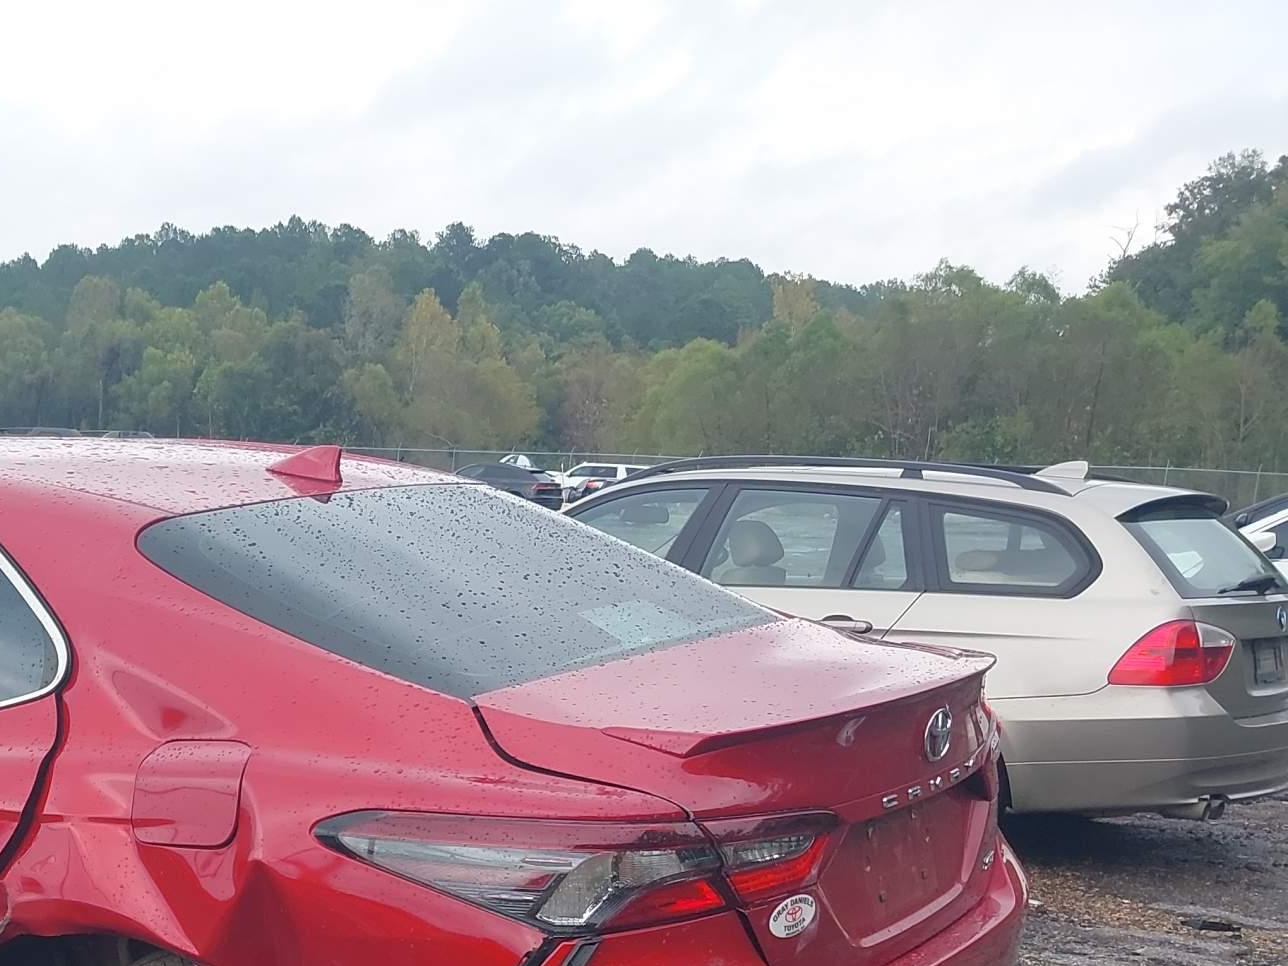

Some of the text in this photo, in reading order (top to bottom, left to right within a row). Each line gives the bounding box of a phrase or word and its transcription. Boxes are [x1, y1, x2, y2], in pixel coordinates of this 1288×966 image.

[882, 759, 974, 809] CAMRY
[789, 896, 814, 908] DANIELS
[784, 917, 806, 932] TOYOTA
